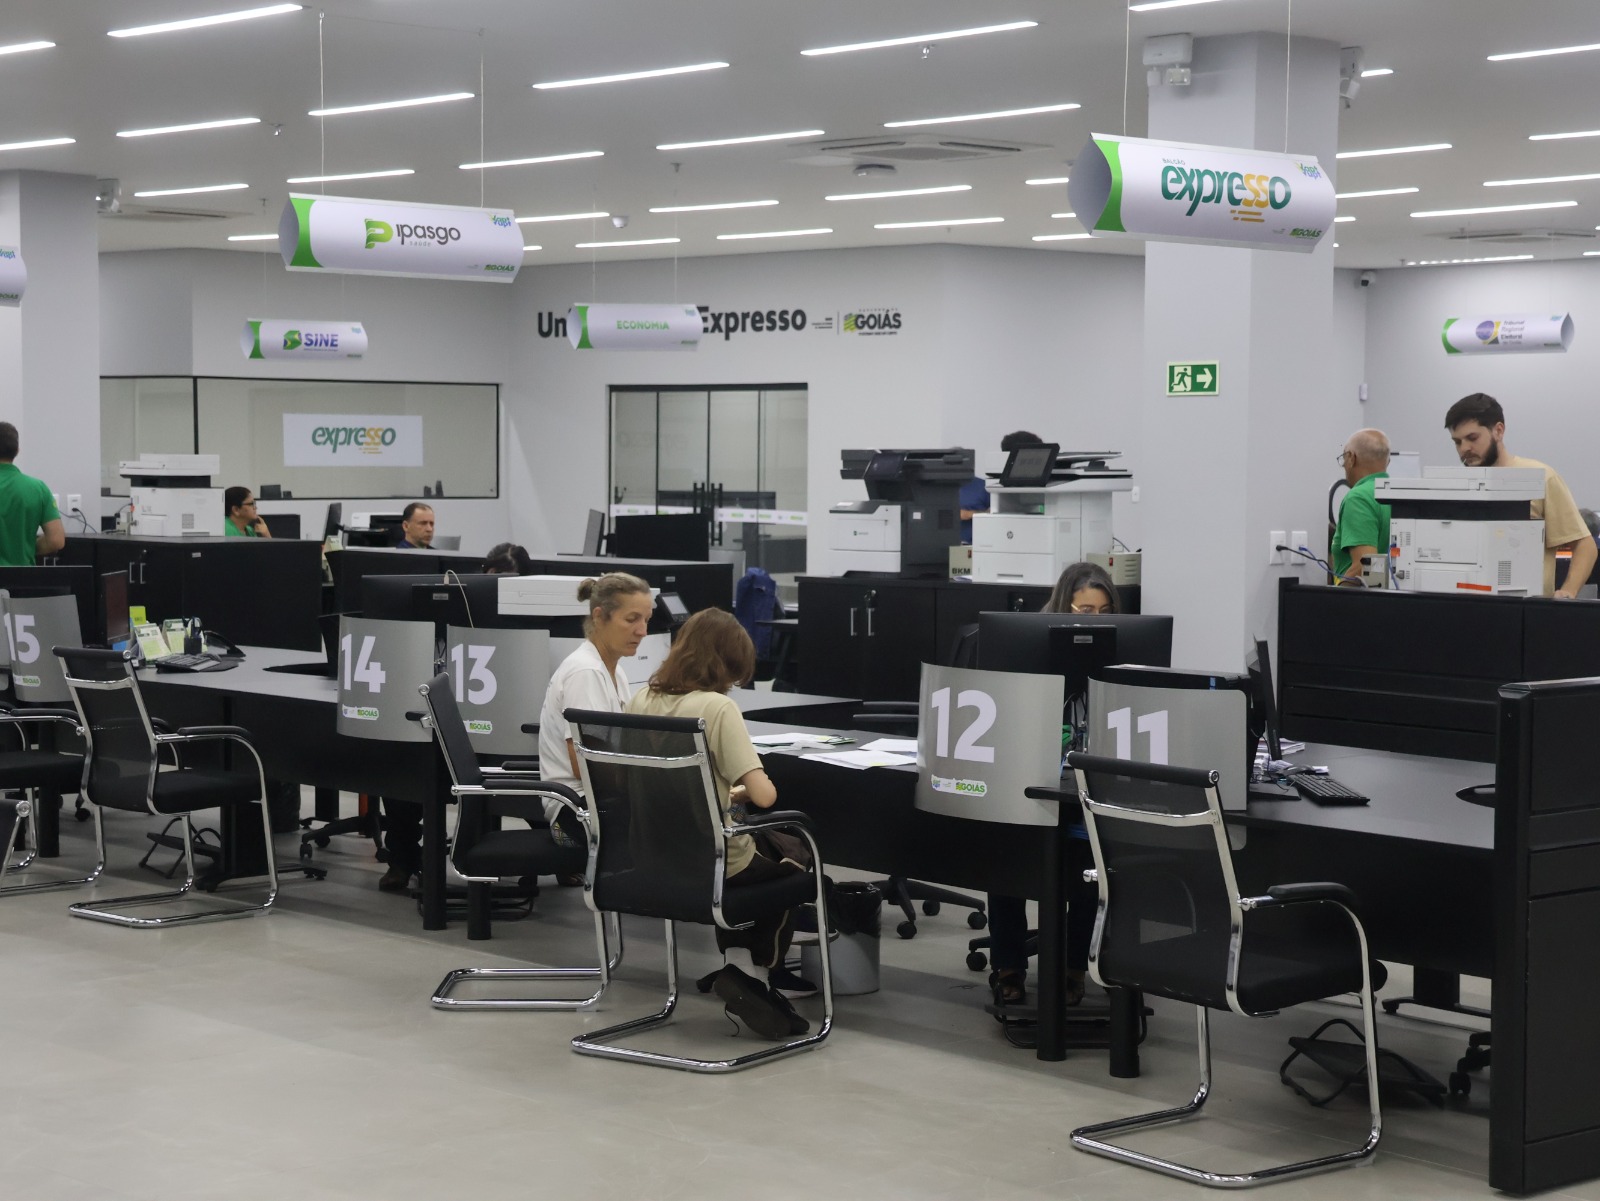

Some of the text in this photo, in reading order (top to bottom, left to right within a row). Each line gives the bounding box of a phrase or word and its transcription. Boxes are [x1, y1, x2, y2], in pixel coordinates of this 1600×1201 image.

[1161, 165, 1292, 217] expresso
[304, 333, 339, 348] SINE
[617, 320, 669, 330] ECONOMIA
[697, 305, 808, 341] Expresso
[855, 309, 902, 331] GOIÁS
[311, 426, 397, 454] expresso
[4, 612, 40, 664] 15
[341, 634, 386, 693] 14
[451, 643, 498, 705] 13
[931, 687, 997, 763] 12
[1107, 707, 1169, 767] 11
[961, 782, 985, 793] GOIÁS
